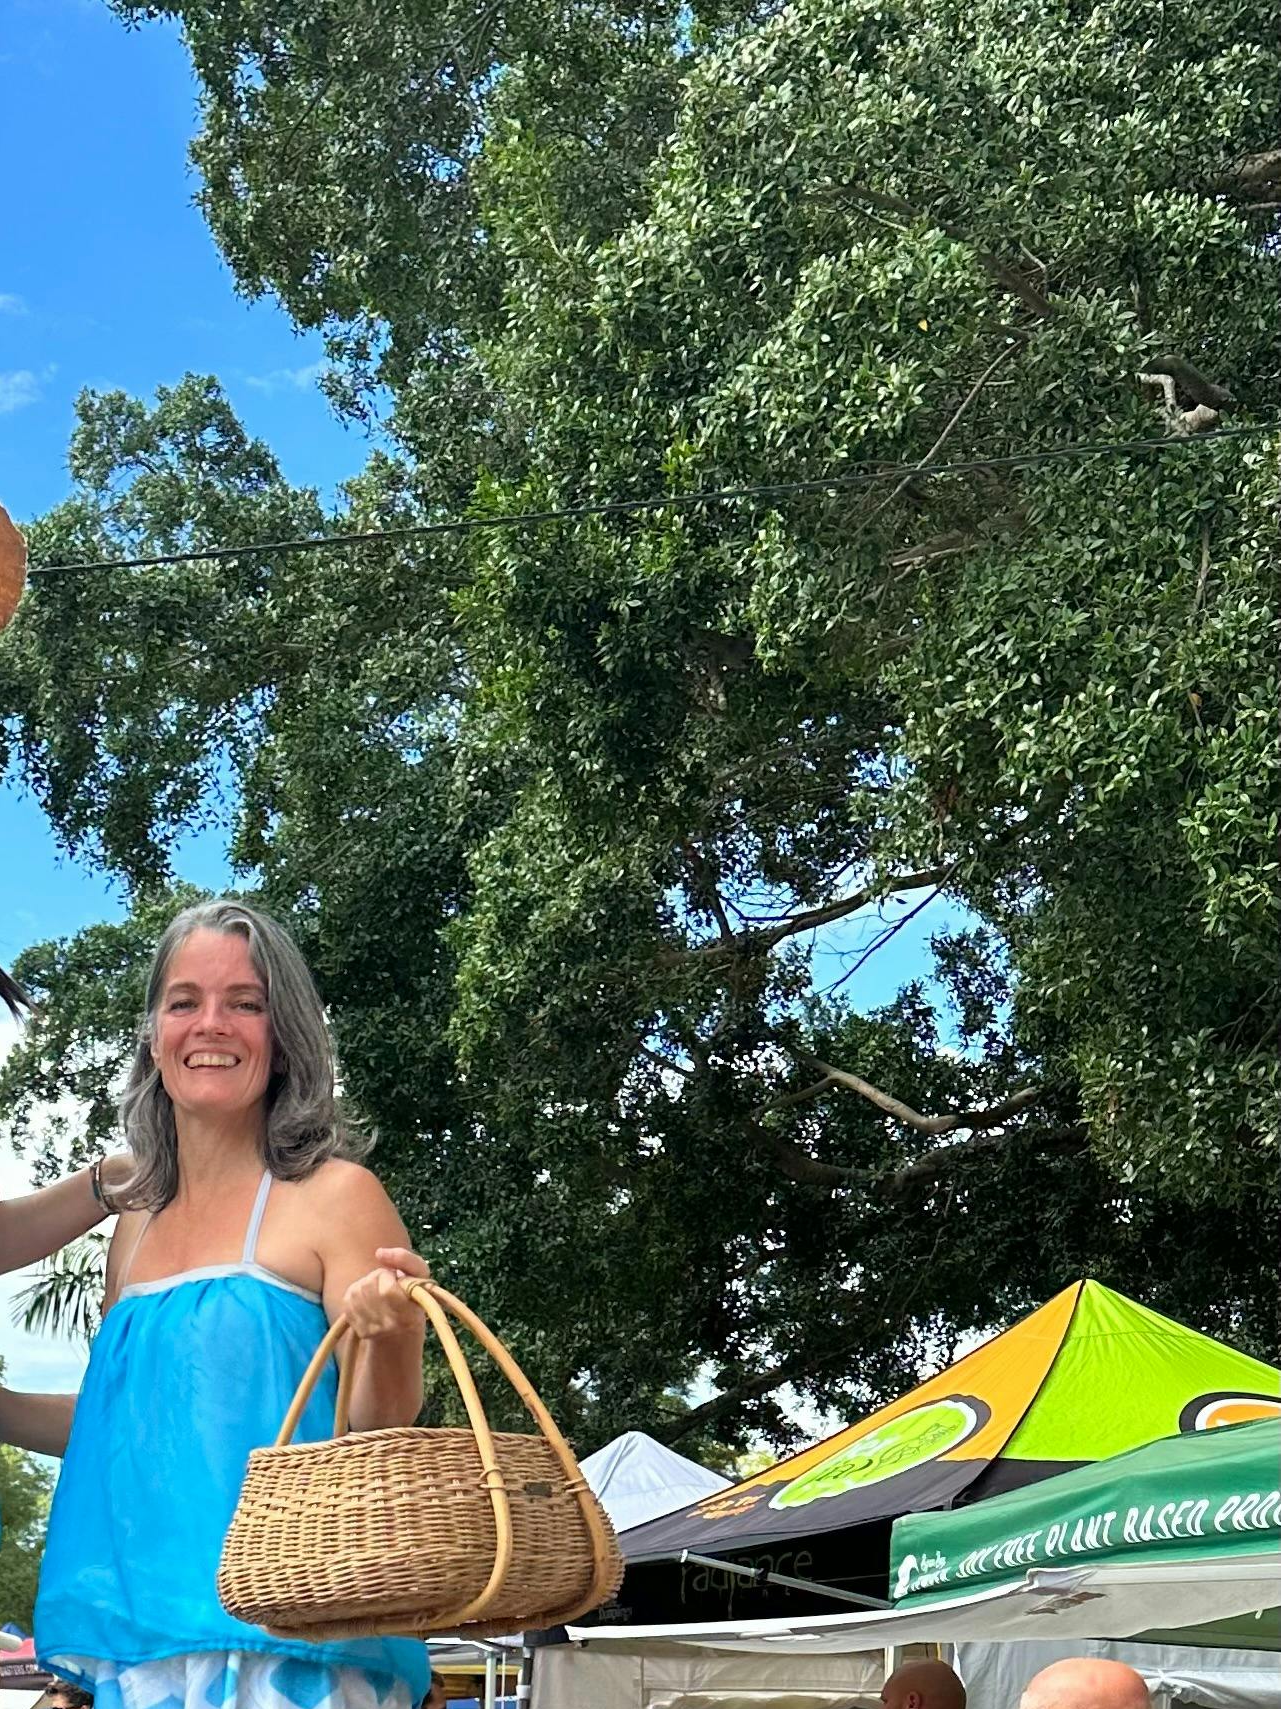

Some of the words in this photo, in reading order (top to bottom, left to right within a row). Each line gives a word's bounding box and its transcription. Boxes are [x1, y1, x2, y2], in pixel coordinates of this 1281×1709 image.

[993, 1530, 1043, 1568] FREE
[1045, 1511, 1117, 1557] PLANT
[1123, 1499, 1209, 1544] BASED
